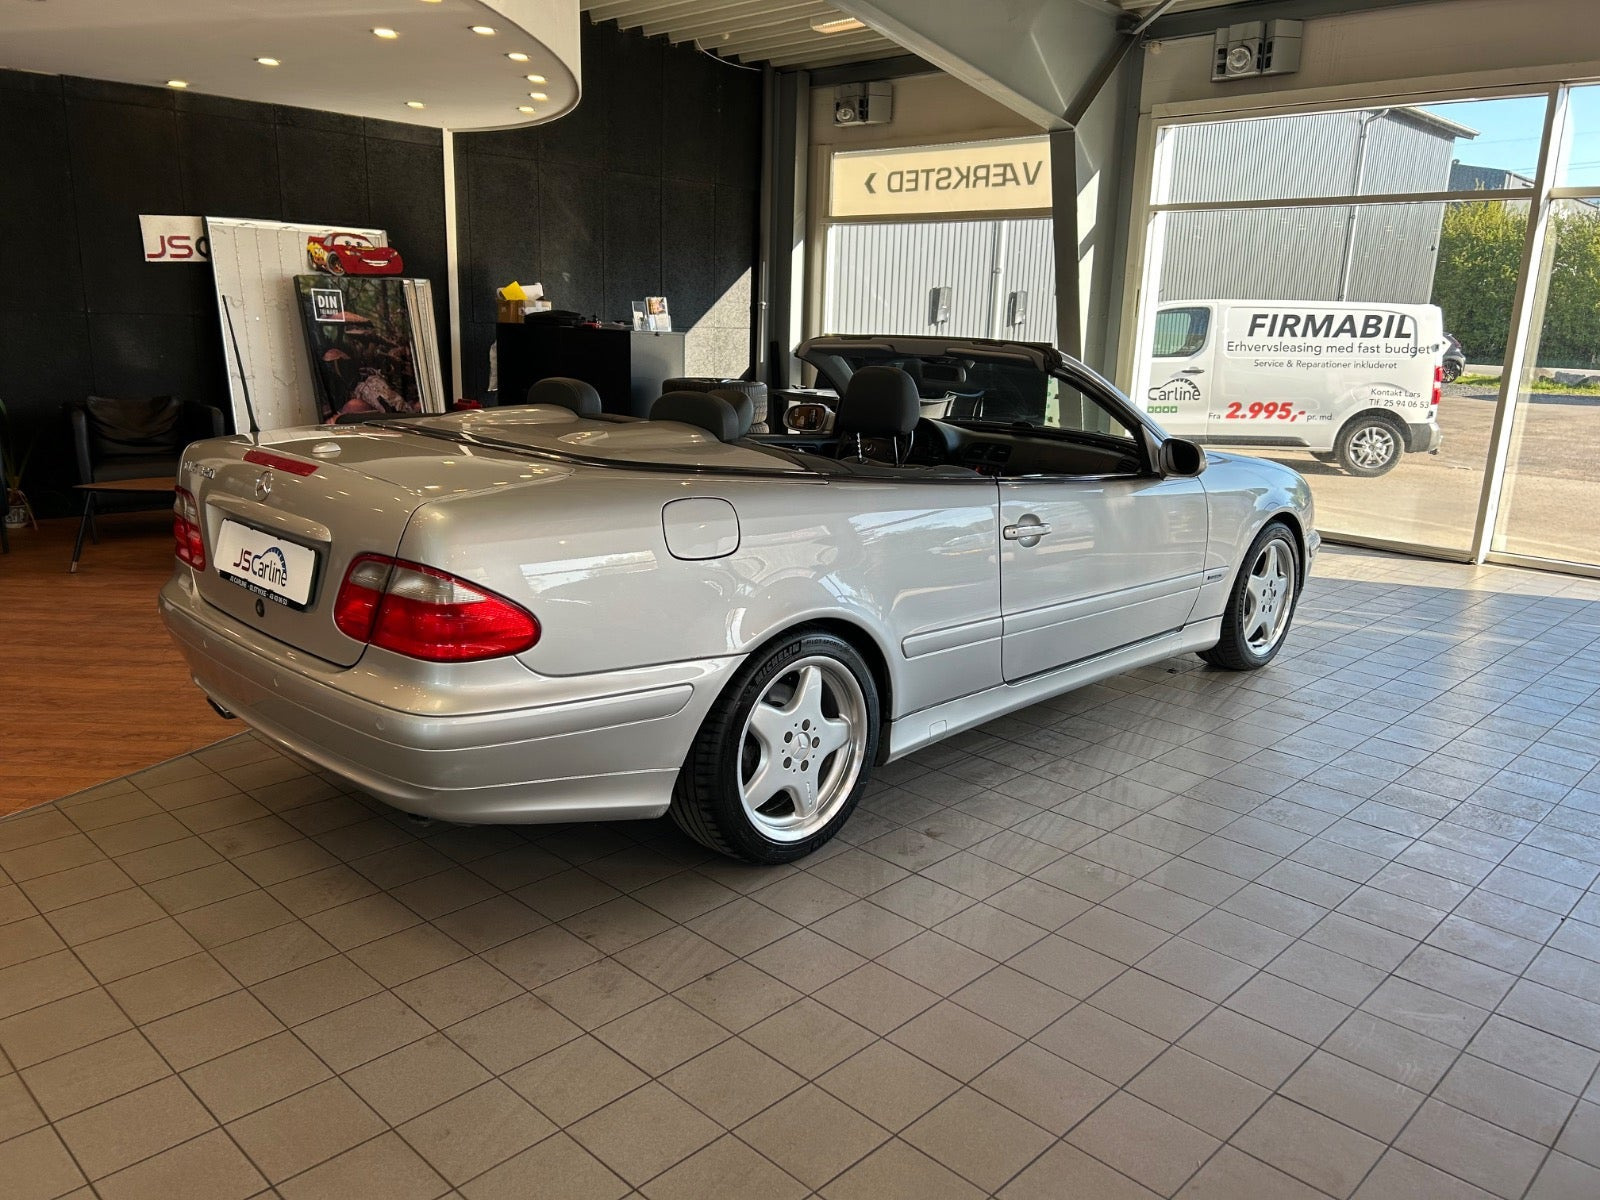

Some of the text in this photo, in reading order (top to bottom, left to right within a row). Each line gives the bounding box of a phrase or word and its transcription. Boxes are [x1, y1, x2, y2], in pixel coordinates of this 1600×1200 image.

[317, 295, 338, 309] DIN
[1247, 313, 1412, 339] FIRMABIL
[1227, 341, 1431, 358] Erhvervsleasing med fast budget
[1253, 359, 1398, 370] Service & Reparationer inkluderet
[1148, 387, 1201, 401] Carline
[1370, 388, 1421, 398] Kontakt Lars
[1384, 399, 1394, 407] 25
[1407, 400, 1418, 408] 06
[1208, 412, 1221, 420] Fra
[1225, 401, 1306, 422] 2.995,-
[754, 641, 801, 686] MICHELIN
